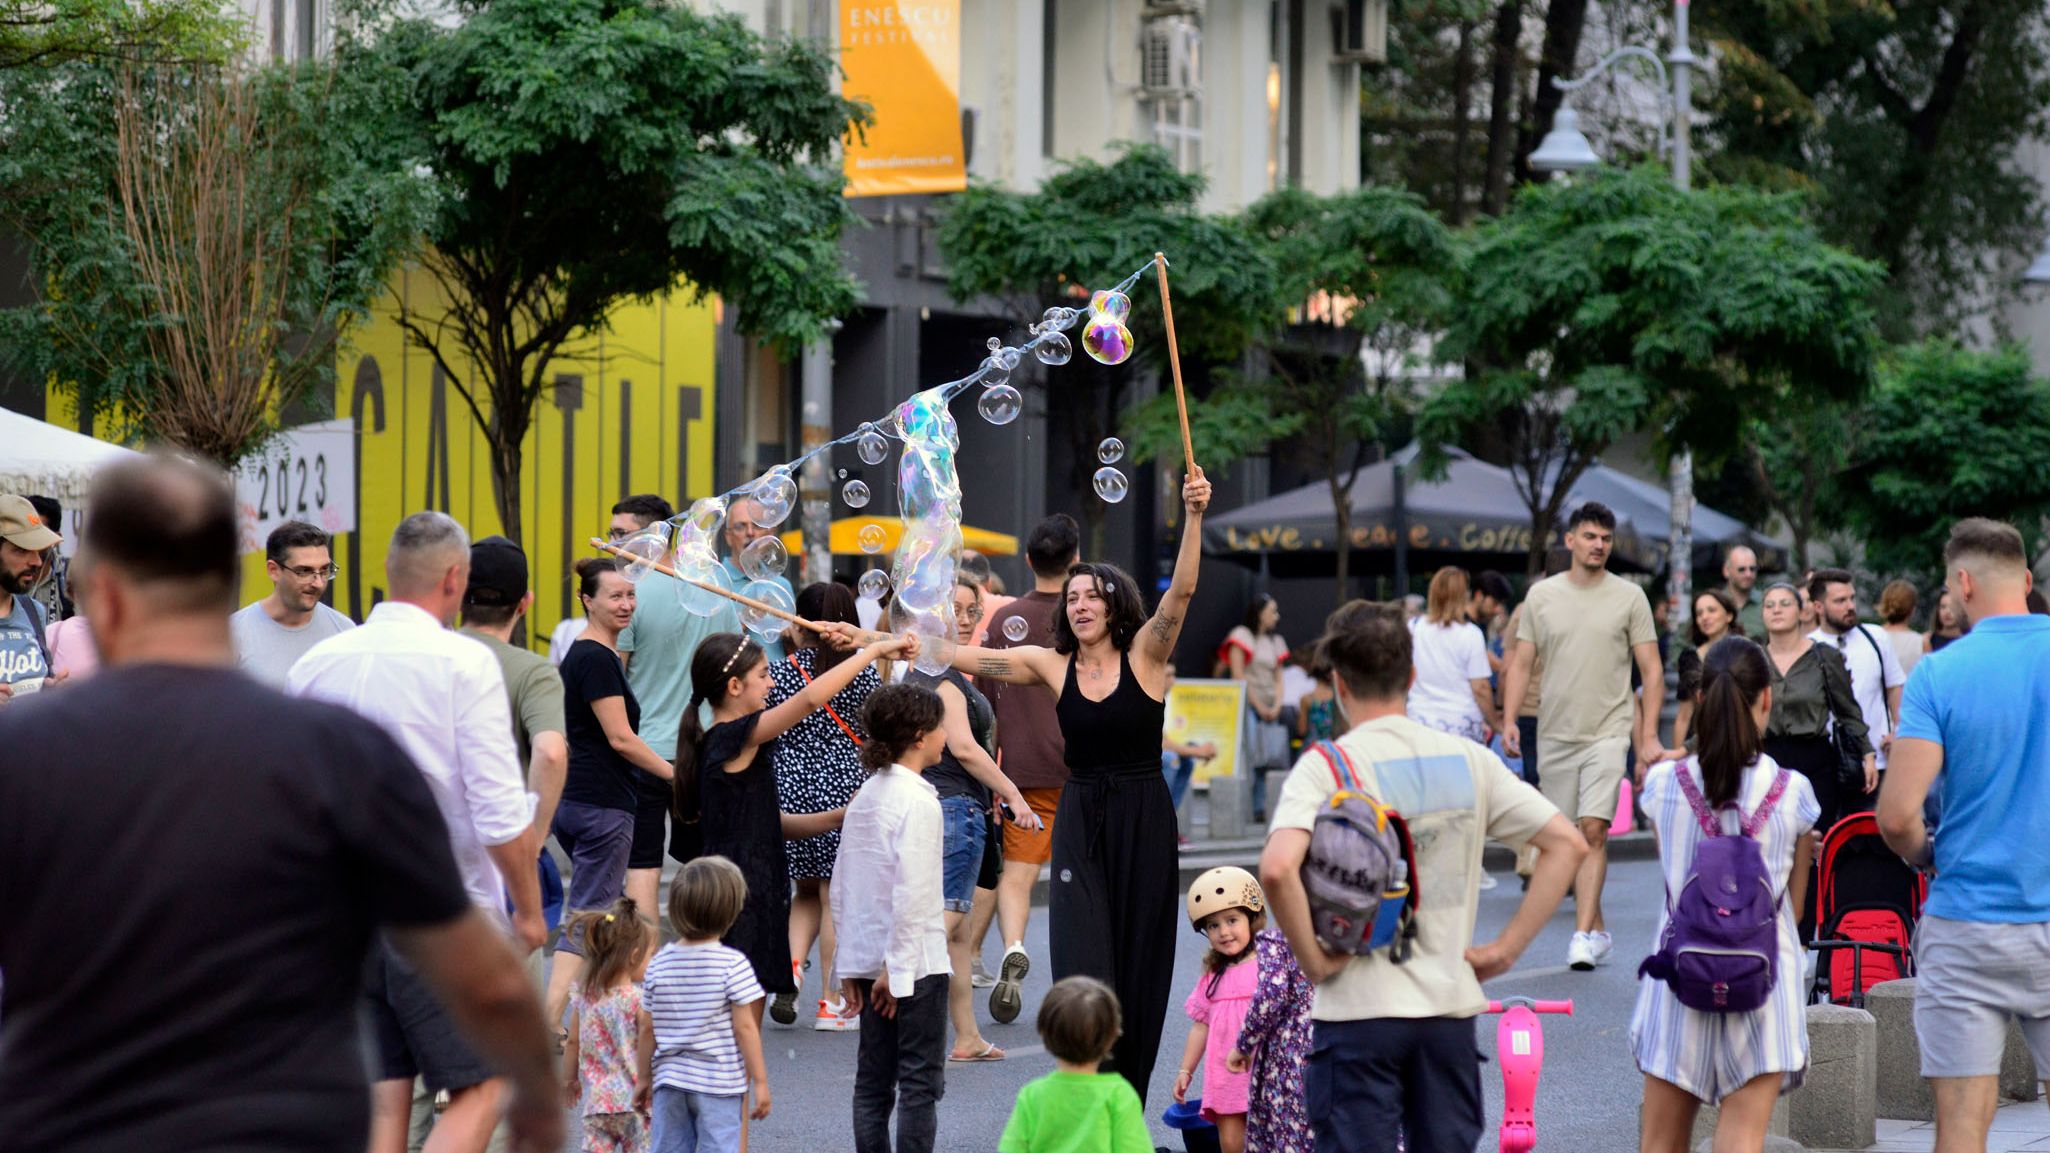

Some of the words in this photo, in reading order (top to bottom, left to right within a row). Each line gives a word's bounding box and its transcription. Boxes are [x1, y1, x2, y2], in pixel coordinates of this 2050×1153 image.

[850, 6, 951, 27] ENESCU
[850, 30, 949, 45] FESTIVAL
[257, 453, 327, 521] 2023
[1226, 525, 1299, 550] Love
